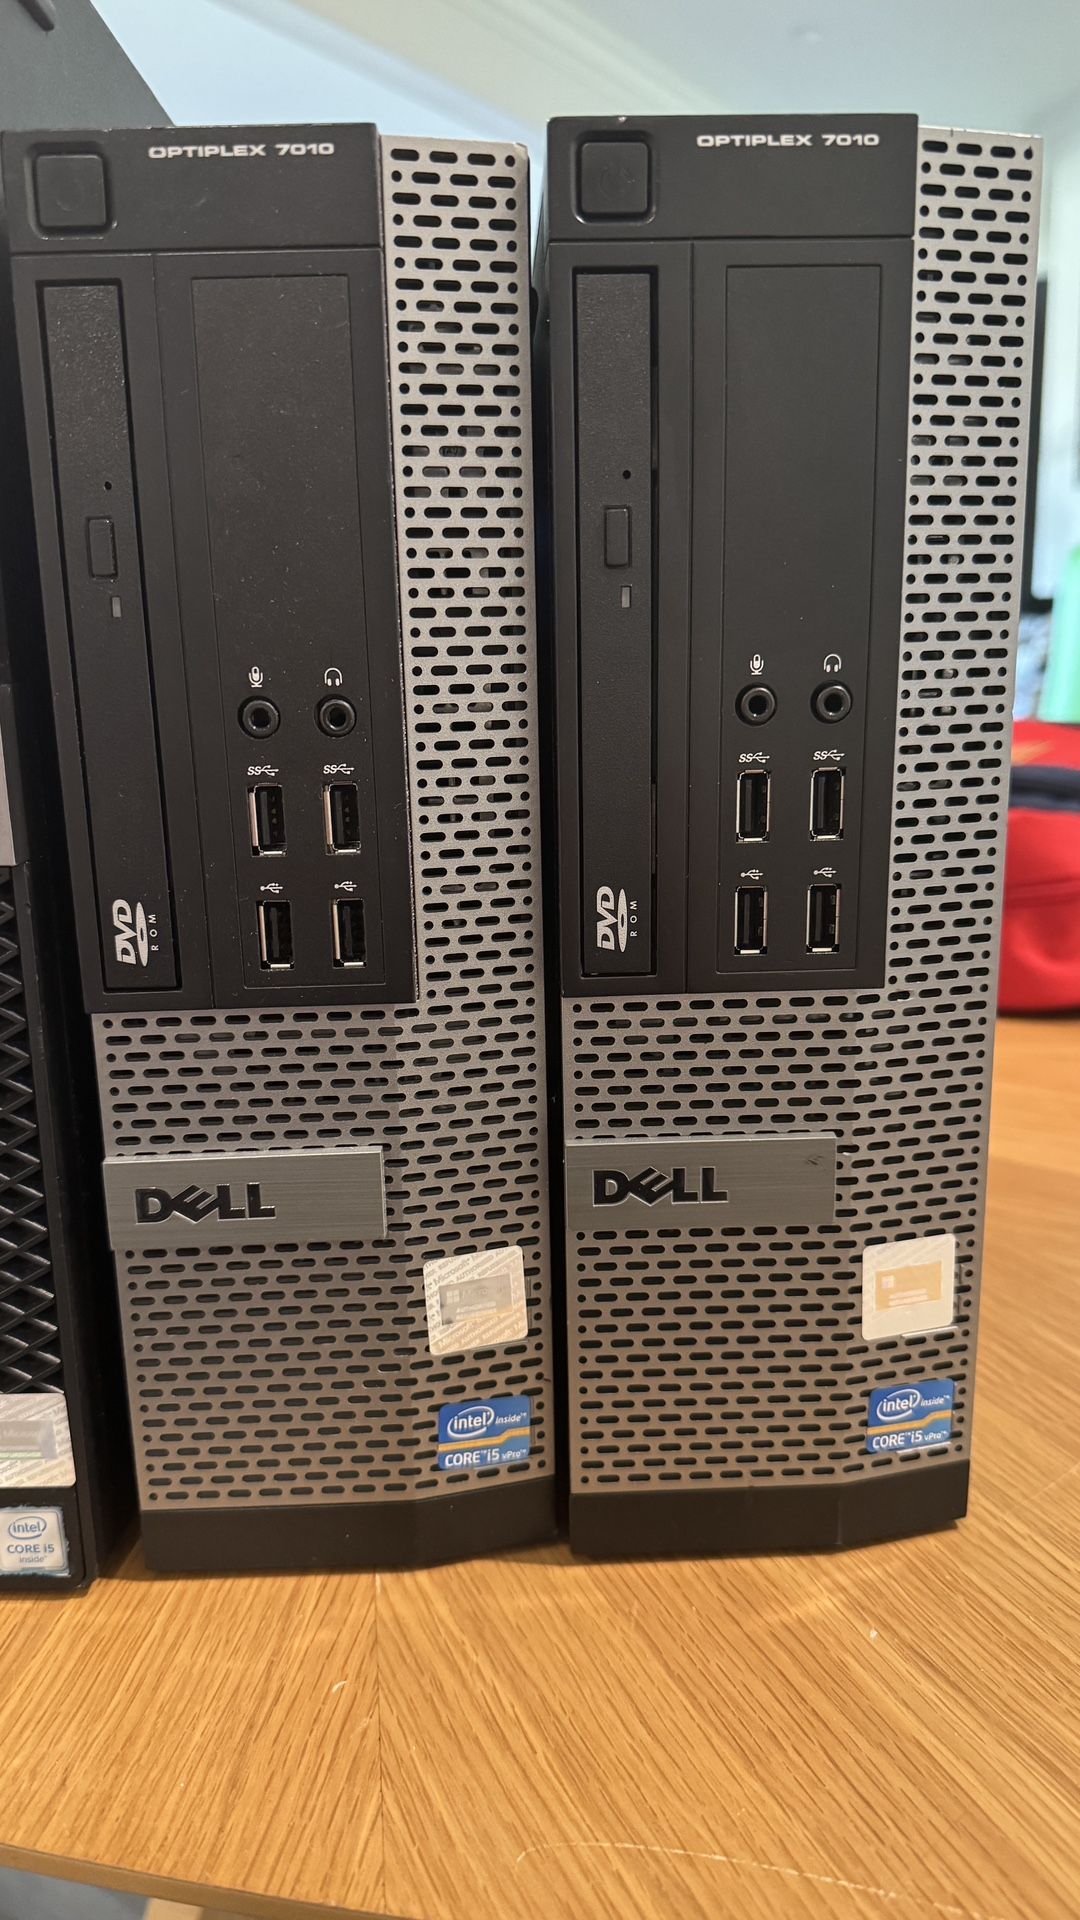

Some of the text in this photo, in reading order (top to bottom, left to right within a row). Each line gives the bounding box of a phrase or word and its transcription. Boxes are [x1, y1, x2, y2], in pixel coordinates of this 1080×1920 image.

[696, 134, 880, 148] OPTIPLEX 7010
[148, 143, 335, 159] OPTIPLEX 7010
[596, 886, 618, 951] DVD
[629, 900, 638, 937] ROM
[112, 899, 137, 965] DVD
[148, 914, 159, 951] ROM
[592, 1166, 729, 1207] DELL
[134, 1181, 276, 1224] DELL
[882, 1394, 913, 1413] intel
[453, 1411, 487, 1430] intel
[911, 1430, 923, 1443] i5
[487, 1448, 500, 1462] i5
[7, 1543, 55, 1554] CORE i5
